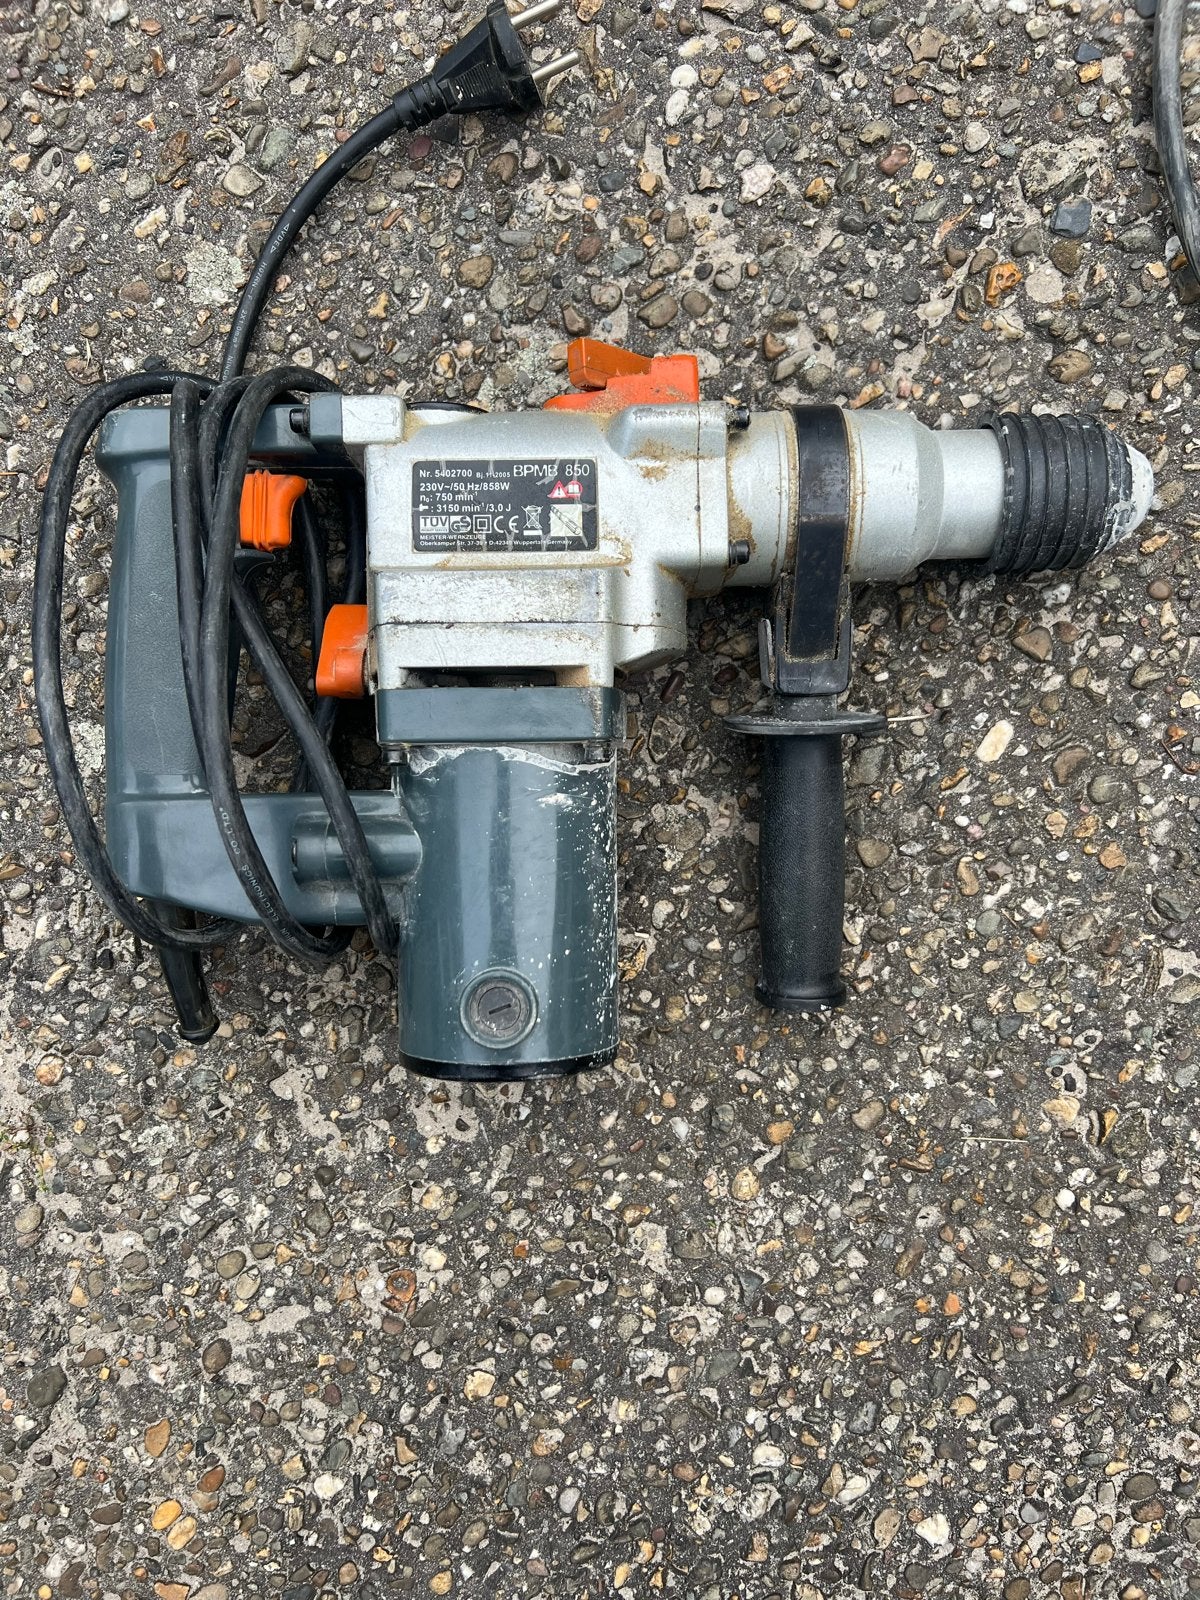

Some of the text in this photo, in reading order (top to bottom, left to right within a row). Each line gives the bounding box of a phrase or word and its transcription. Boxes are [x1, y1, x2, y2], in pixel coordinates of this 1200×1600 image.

[419, 469, 433, 478] Nr.
[434, 469, 473, 478] 5402700
[513, 463, 590, 477] BPMB 850
[435, 492, 453, 501] 750
[436, 503, 460, 512] 3150
[505, 503, 511, 512] J
[421, 516, 448, 527] TÜV
